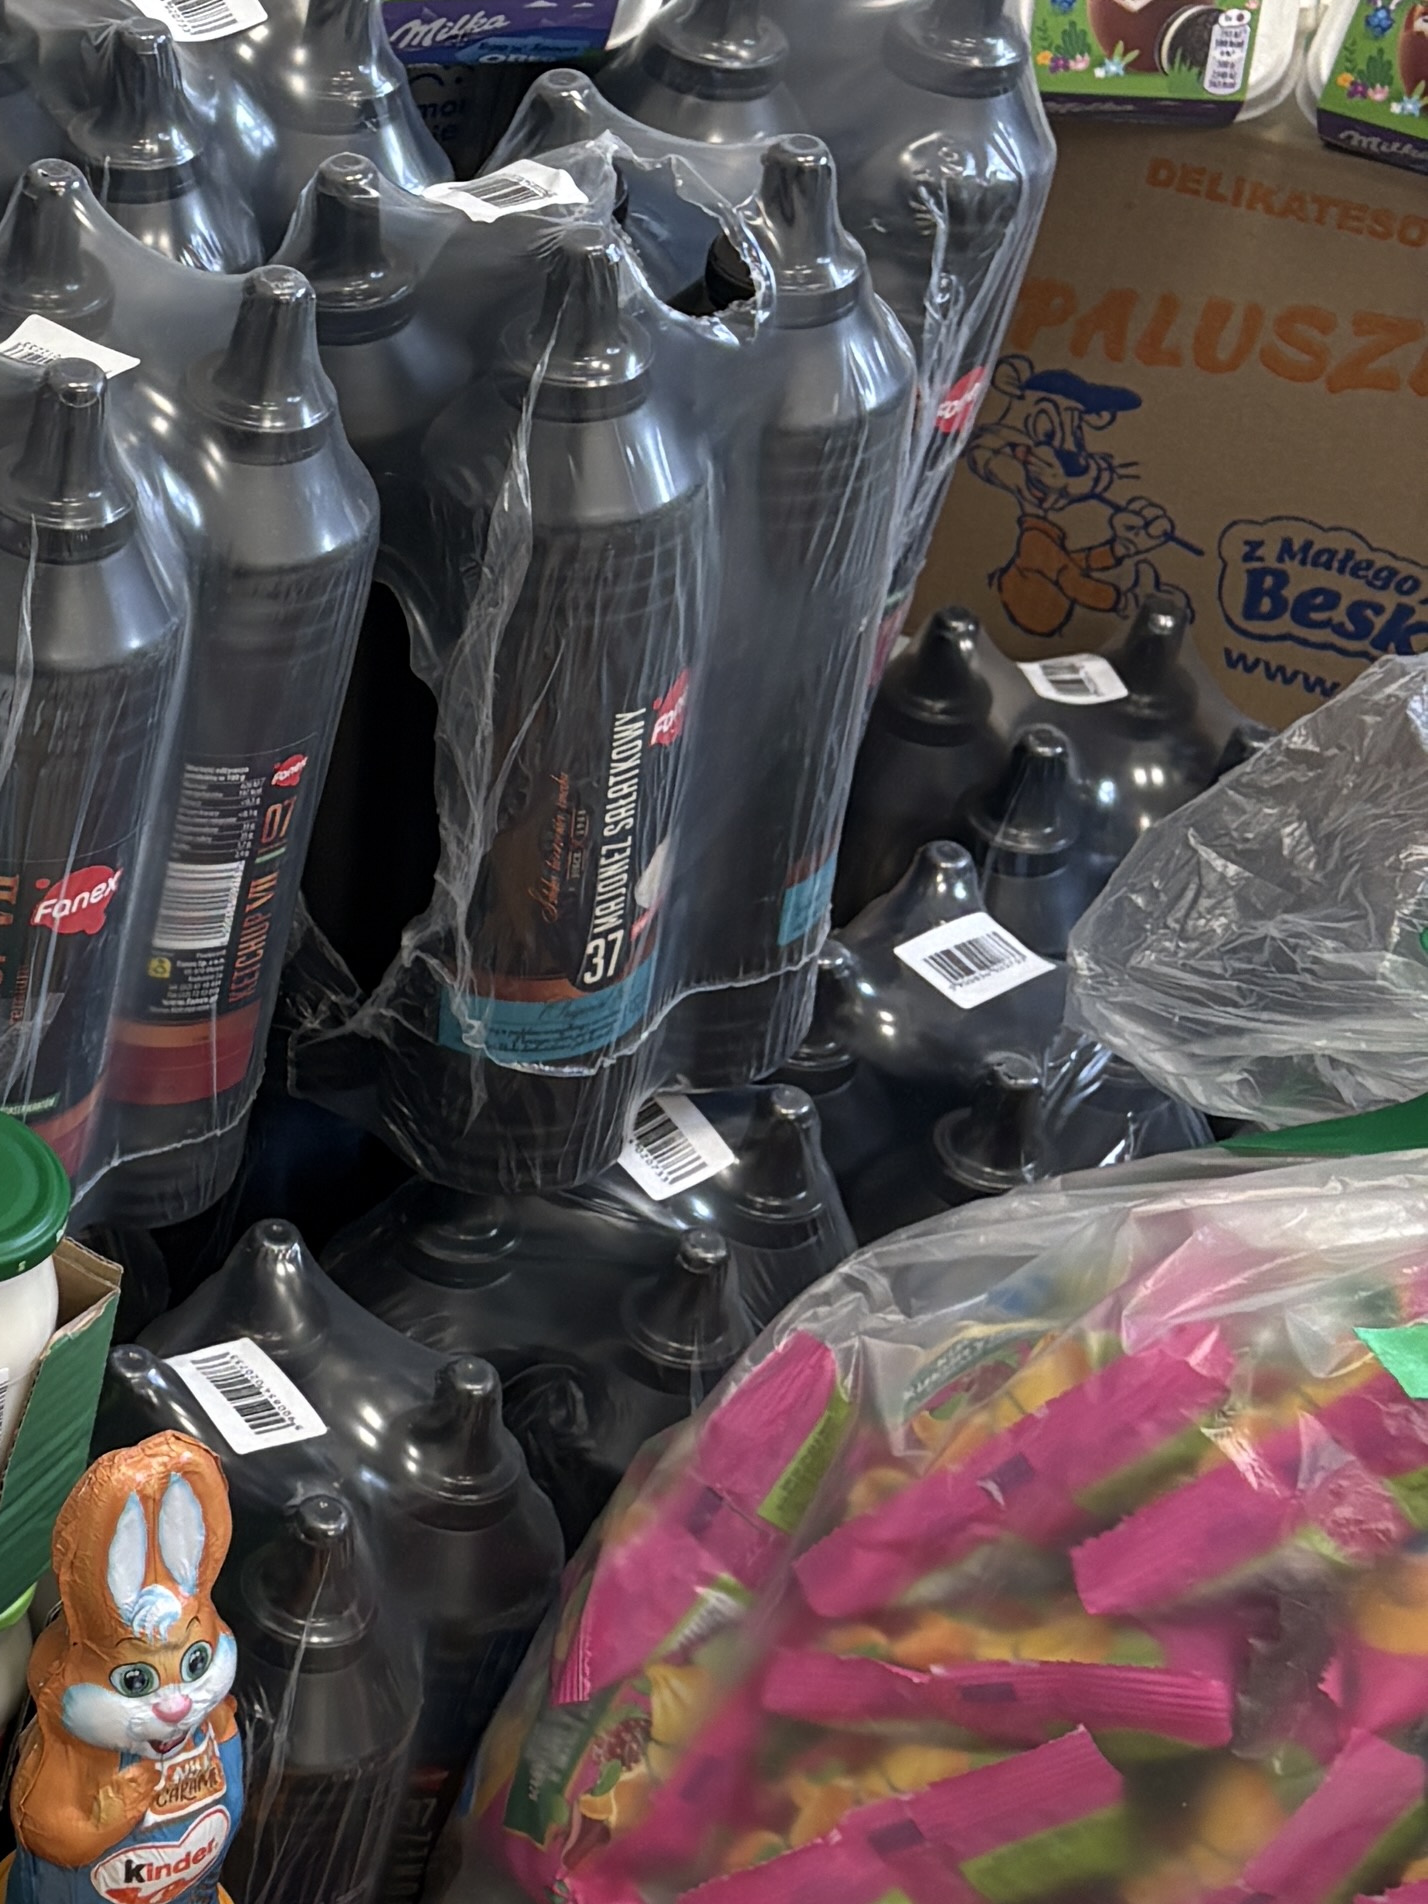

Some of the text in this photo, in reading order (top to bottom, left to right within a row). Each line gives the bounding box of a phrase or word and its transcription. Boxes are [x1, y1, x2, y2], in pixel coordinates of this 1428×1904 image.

[272, 758, 307, 786] Fanex
[583, 707, 646, 984] 37 MAJONEZ SAŁATKOWY
[33, 868, 123, 926] Fanex
[229, 903, 265, 1004] KETCHUP
[123, 1839, 217, 1884] Kinder
